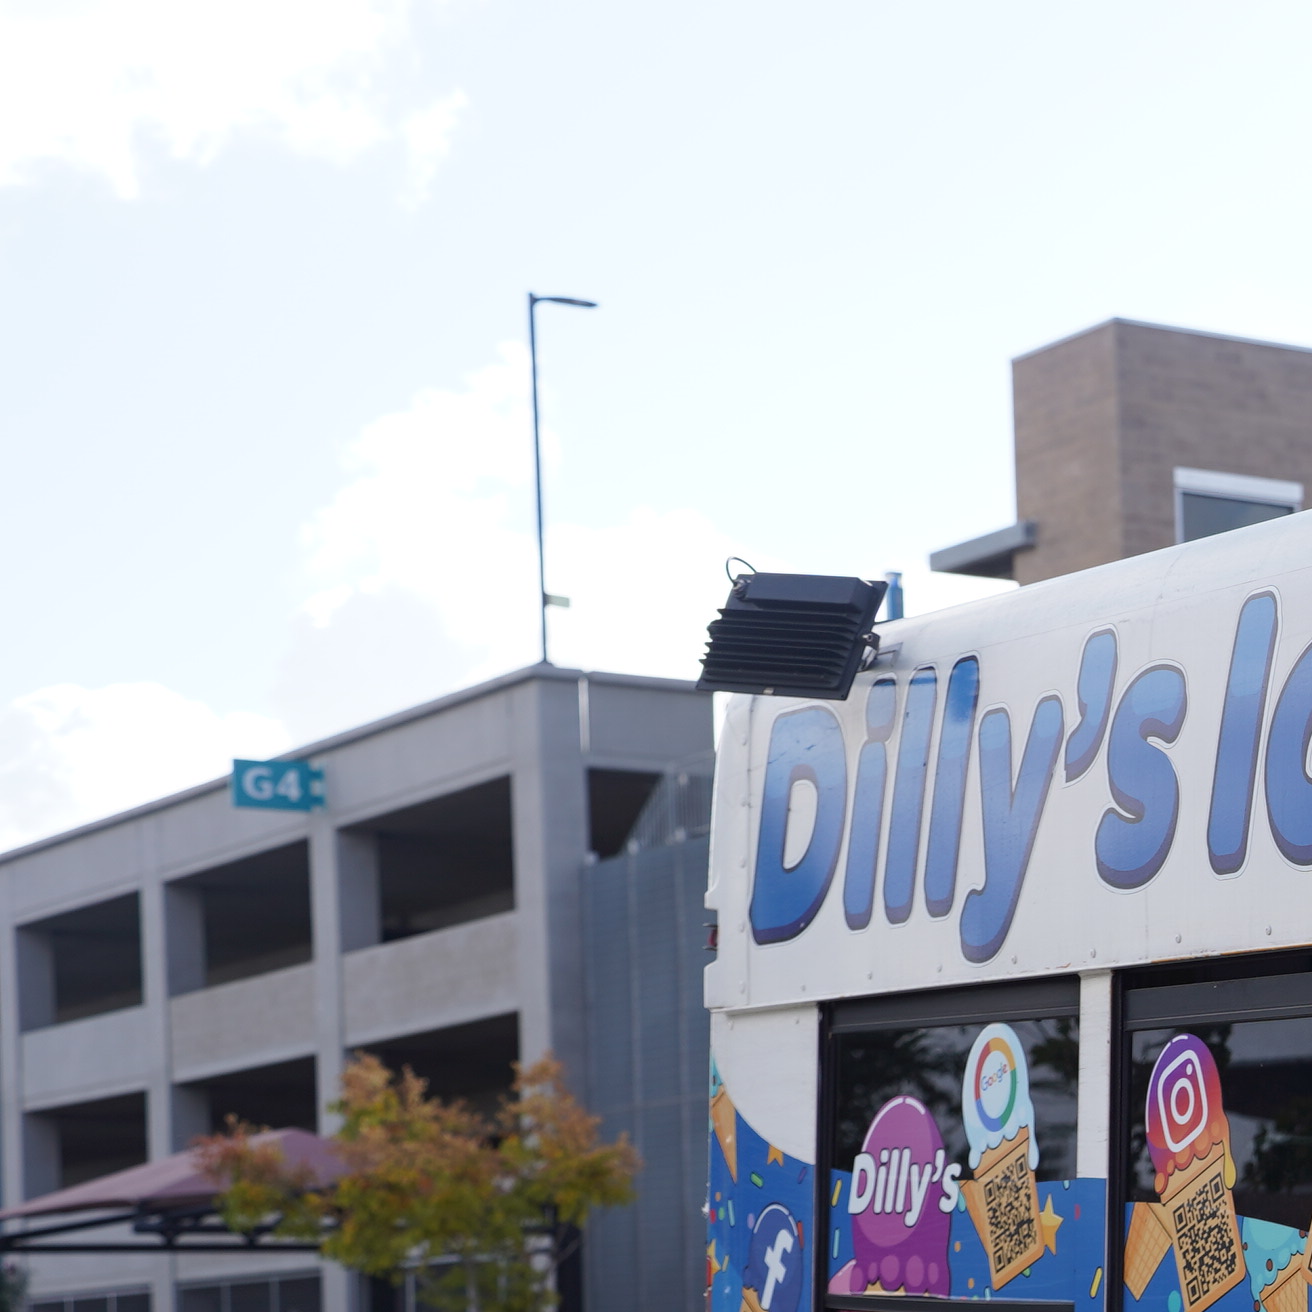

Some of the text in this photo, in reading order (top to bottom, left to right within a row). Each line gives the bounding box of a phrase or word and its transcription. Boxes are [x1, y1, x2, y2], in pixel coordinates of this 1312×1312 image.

[242, 765, 302, 803] G4
[748, 627, 1188, 965] Dilly's
[981, 1061, 1008, 1091] Google
[848, 1147, 962, 1228] Dilly's
